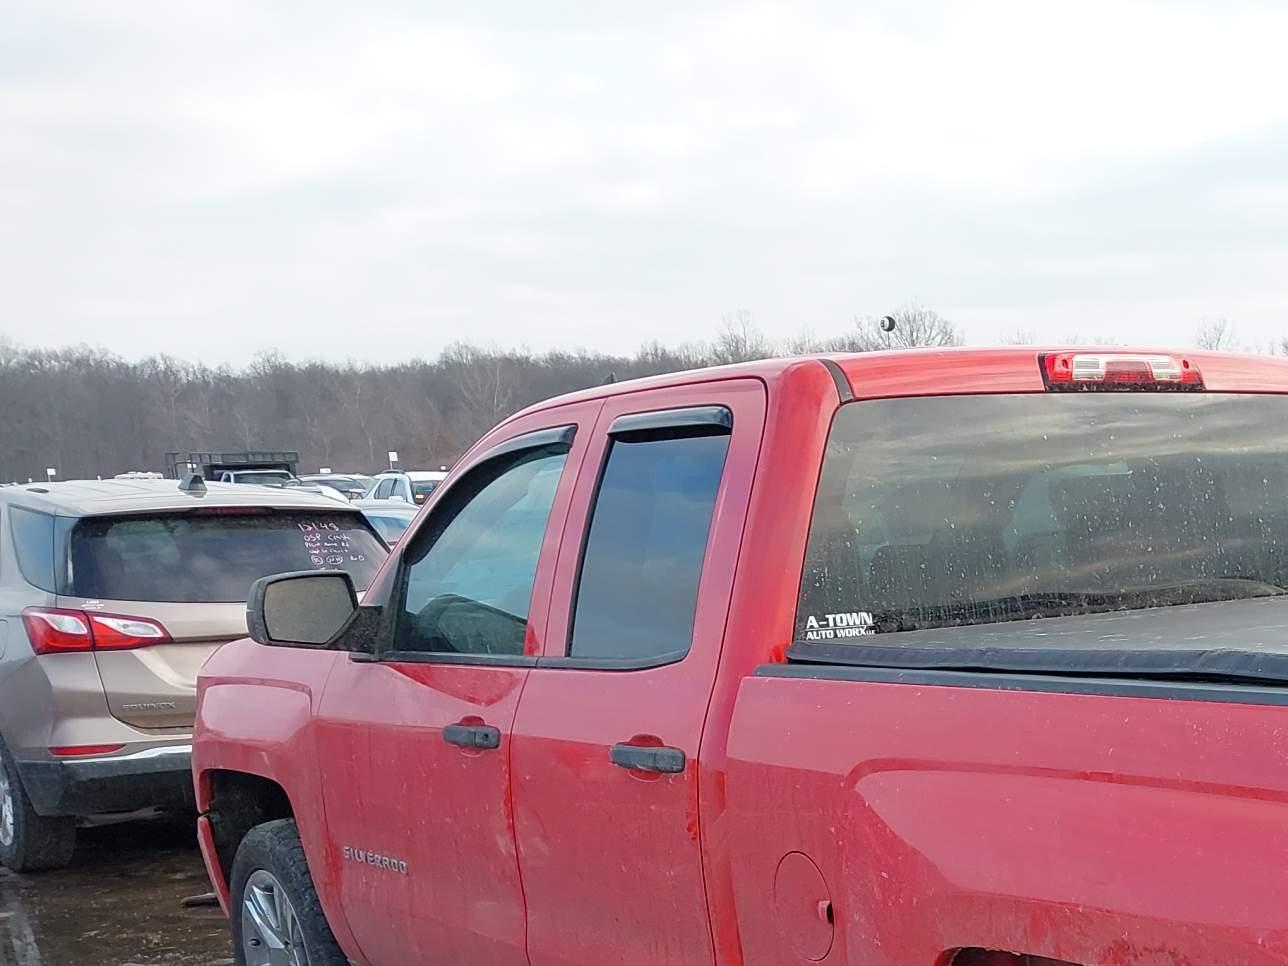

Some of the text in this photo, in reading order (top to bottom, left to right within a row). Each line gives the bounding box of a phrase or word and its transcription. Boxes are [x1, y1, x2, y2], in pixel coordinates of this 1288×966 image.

[806, 612, 873, 629] A-TOWN
[806, 629, 834, 640] AUTO
[836, 626, 867, 638] WORX
[343, 846, 408, 874] SILVERADO
